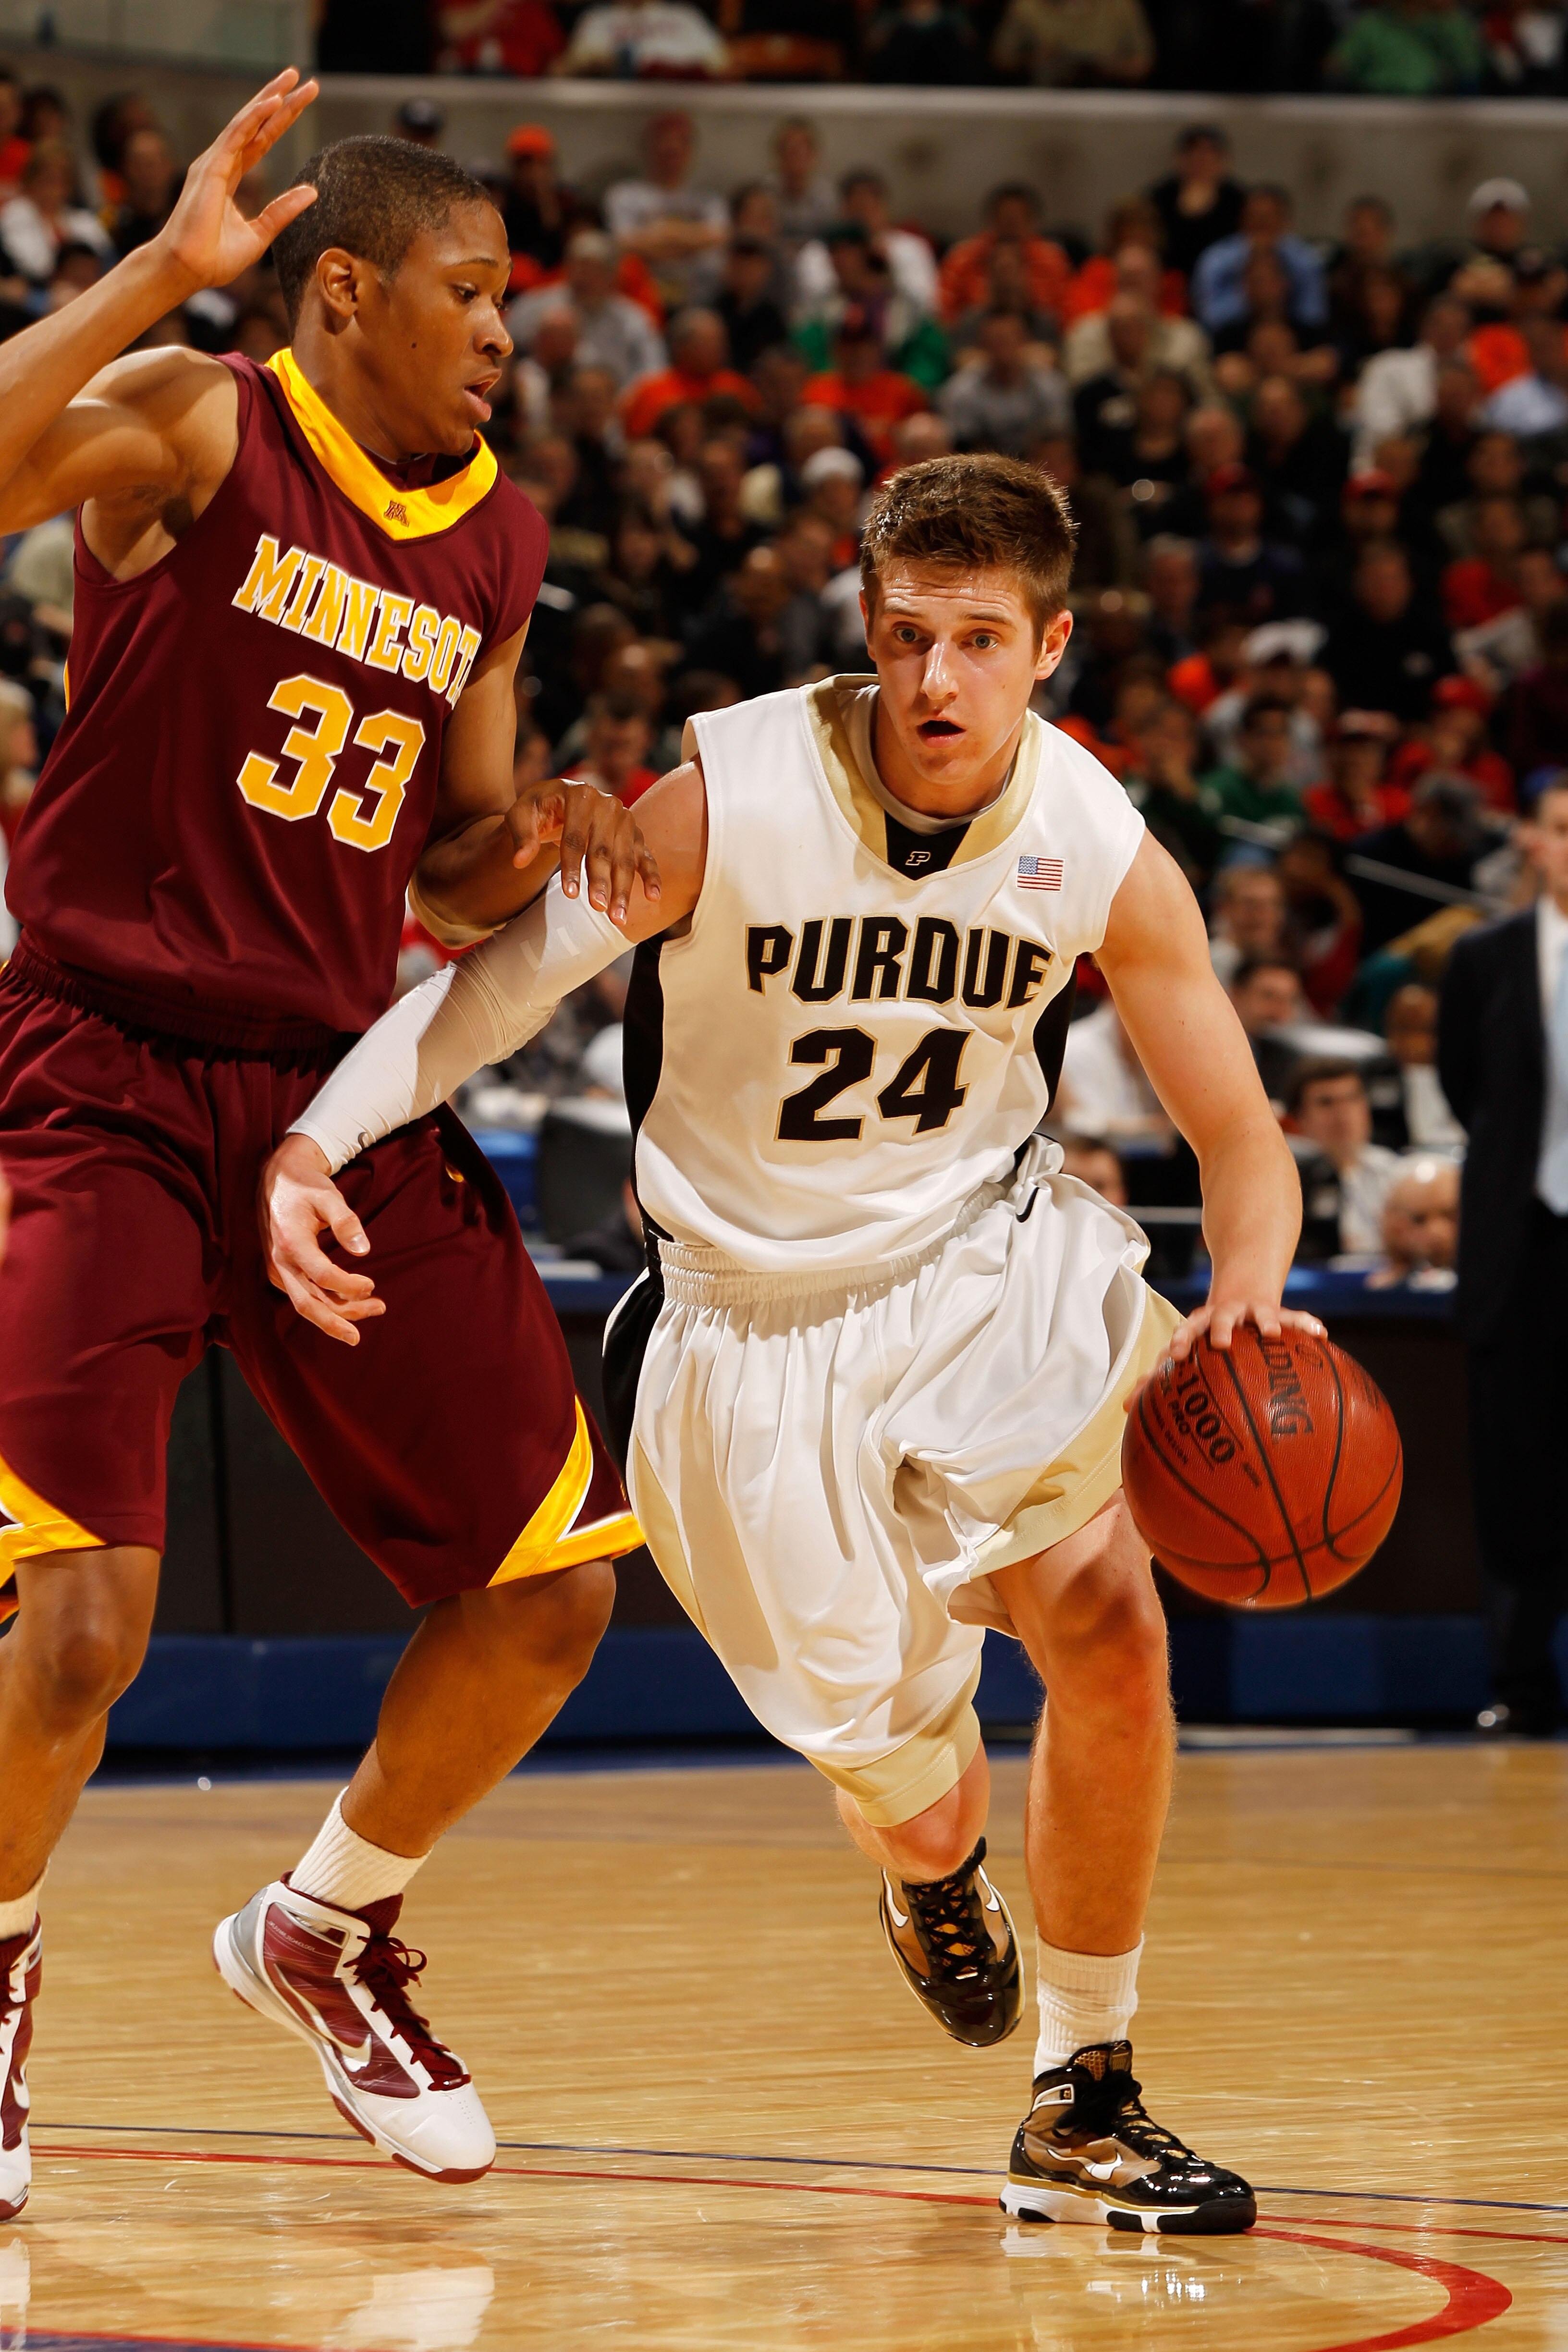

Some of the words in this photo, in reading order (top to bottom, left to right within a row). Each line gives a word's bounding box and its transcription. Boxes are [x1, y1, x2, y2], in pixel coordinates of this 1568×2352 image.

[232, 533, 482, 710] MINNESOT
[236, 673, 426, 853] 33
[905, 851, 931, 866] P
[745, 913, 1055, 1011] PURDUE
[774, 1024, 975, 1142] 24
